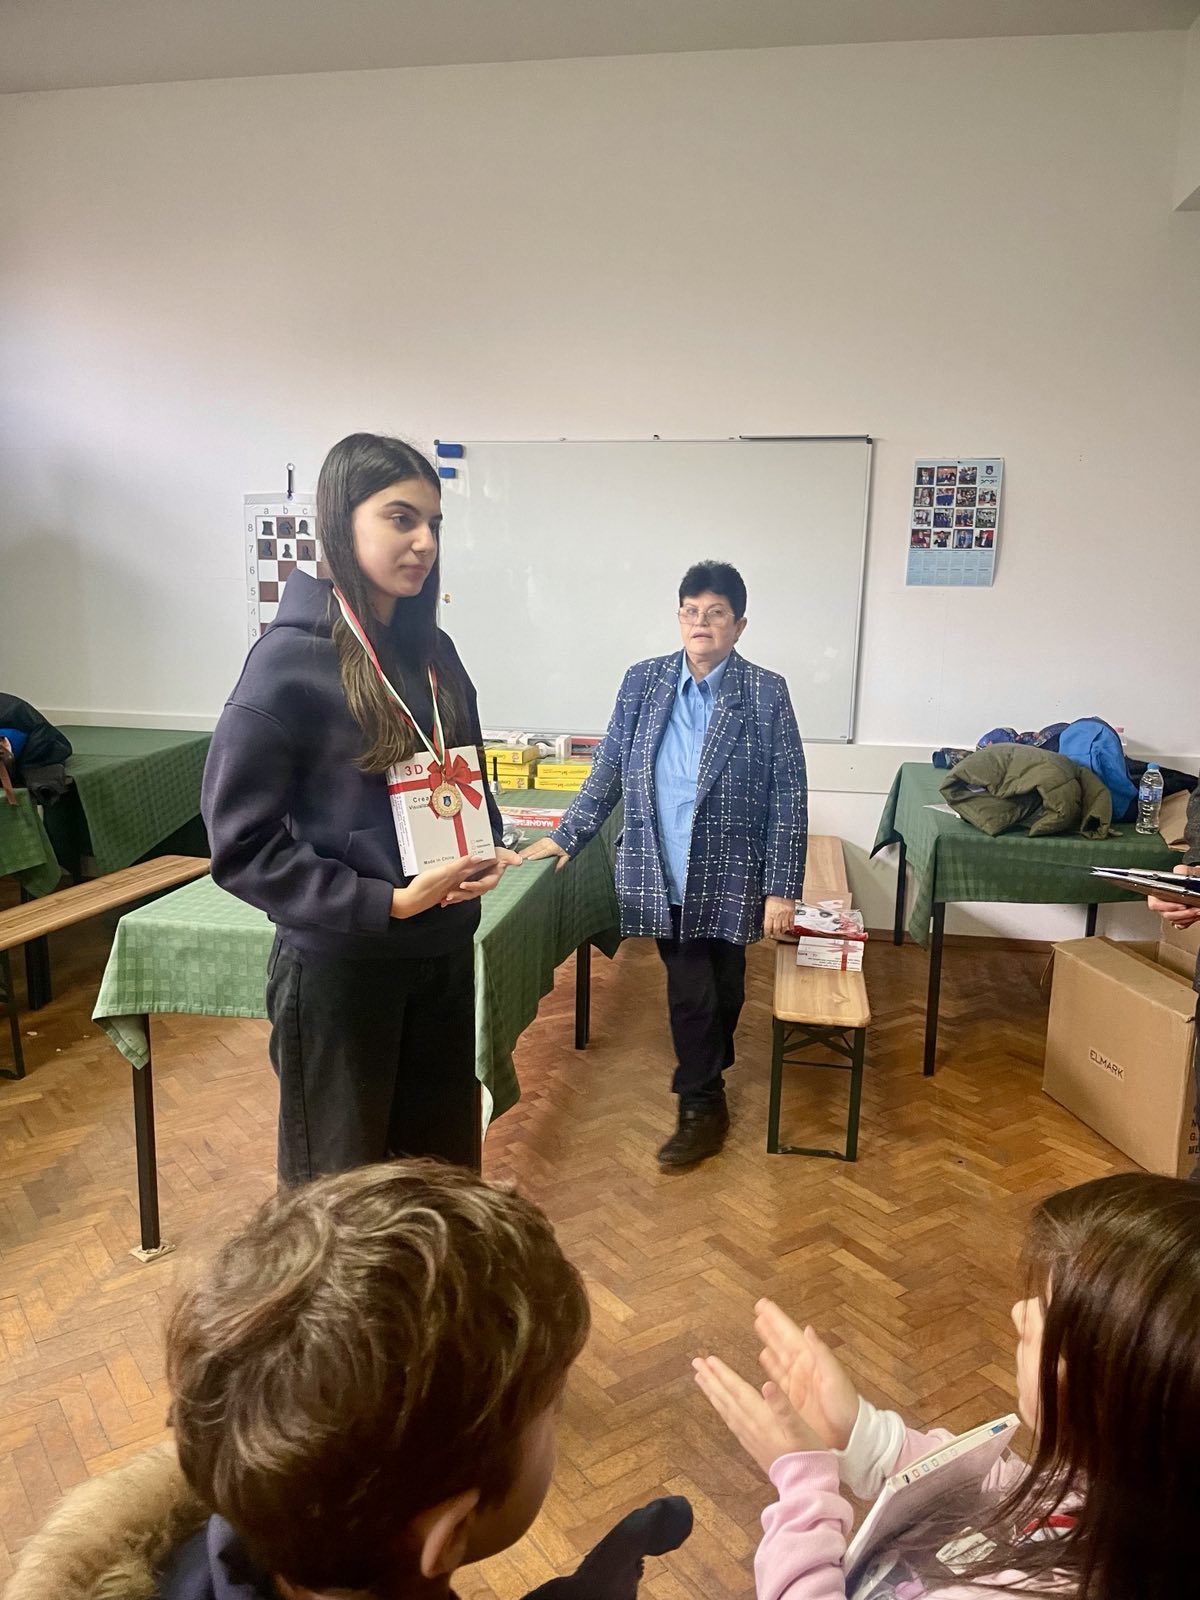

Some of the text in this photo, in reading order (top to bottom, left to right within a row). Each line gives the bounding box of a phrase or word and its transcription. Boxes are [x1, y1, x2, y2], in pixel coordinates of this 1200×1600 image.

[283, 506, 289, 515] b
[247, 524, 254, 532] 8
[249, 545, 254, 553] 7
[249, 567, 255, 575] 6
[250, 588, 256, 596] 5
[251, 629, 257, 637] 3
[1090, 1049, 1124, 1079] ELMARK
